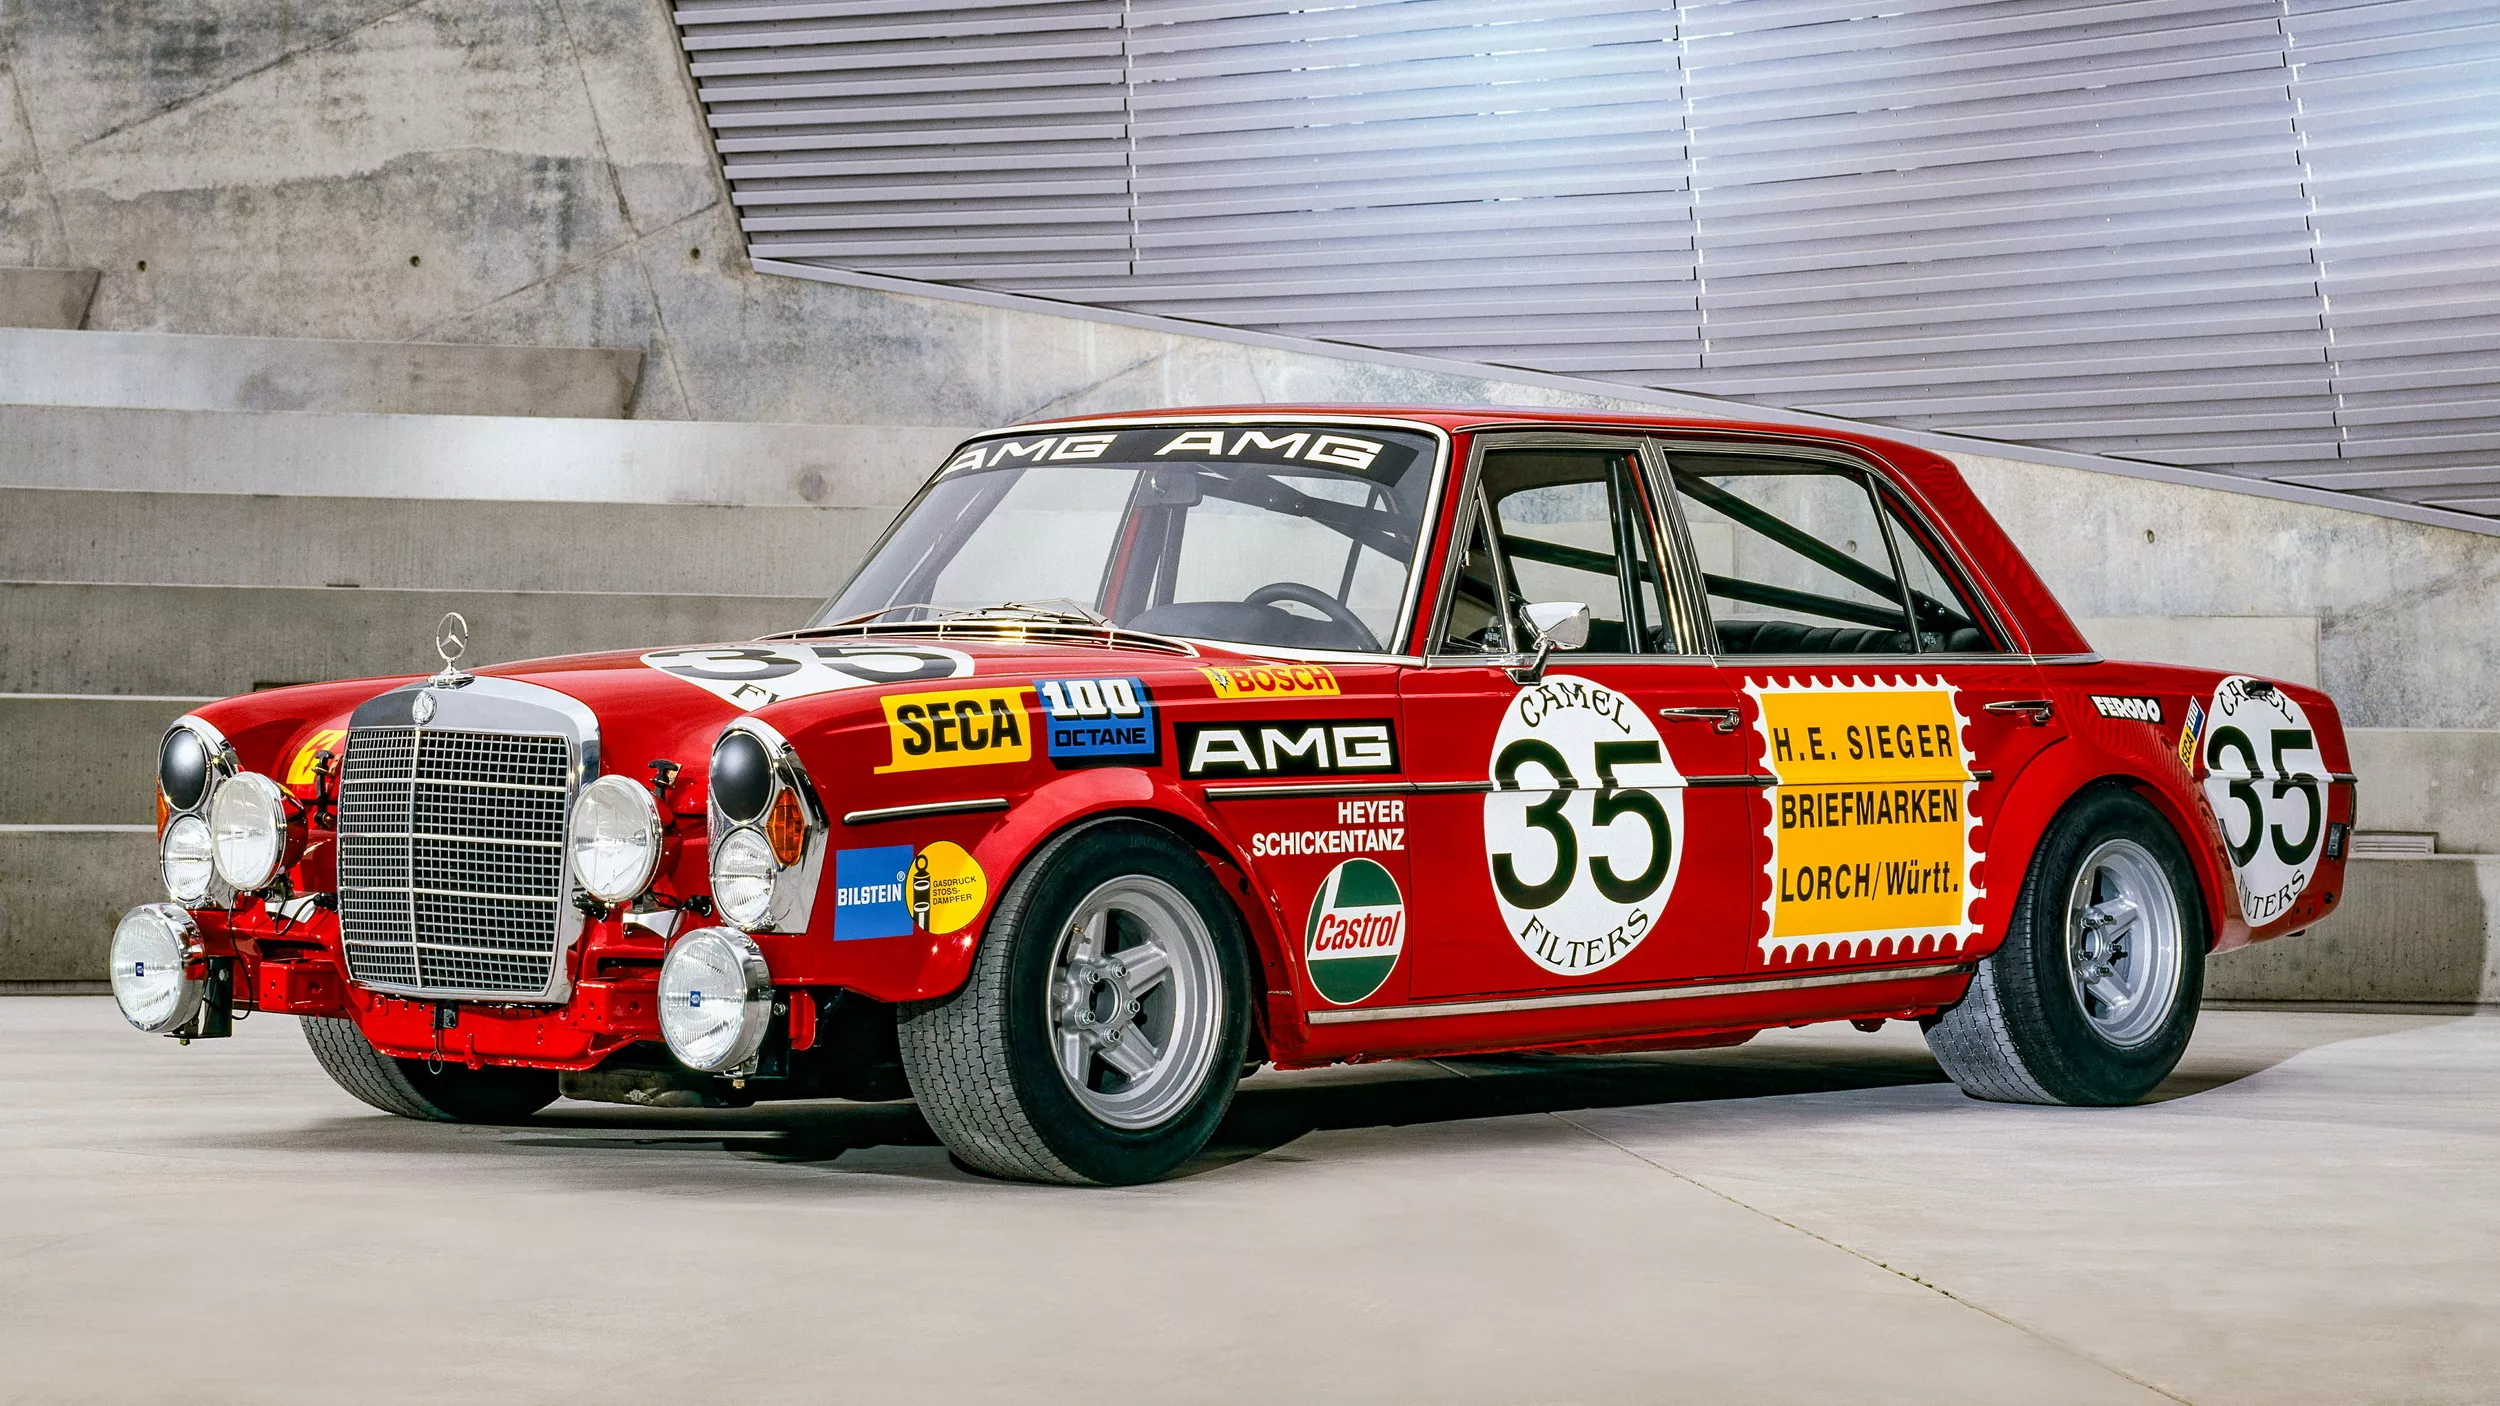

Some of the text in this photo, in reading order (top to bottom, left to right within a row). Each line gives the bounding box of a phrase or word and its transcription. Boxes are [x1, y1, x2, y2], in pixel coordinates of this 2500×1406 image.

[932, 431, 1384, 484] AMG AMG
[648, 645, 957, 684] 35
[1226, 667, 1334, 692] BOSCH
[1042, 679, 1140, 717] 100
[1519, 682, 1631, 735] CAMEL
[2090, 695, 2160, 722] FERODO
[896, 698, 1023, 755] SECA
[1055, 727, 1147, 747] OCTANE
[1846, 724, 1953, 760] SIEGER
[1188, 726, 1391, 772] AMG
[1338, 800, 1404, 824] HEYER
[1781, 788, 1958, 829] BRIEFMARKEN
[2207, 726, 2321, 867] 35
[1252, 828, 1405, 857] SCHICKENTANZ
[1491, 738, 1673, 910] 35
[933, 876, 976, 887] GASDRUCK
[933, 887, 961, 897] STOSS-
[933, 893, 972, 906] DÄMPFER
[1781, 859, 1958, 902] LORCH/Württ.
[1315, 911, 1401, 951] Castrol
[1519, 908, 1649, 968] FILTERS
